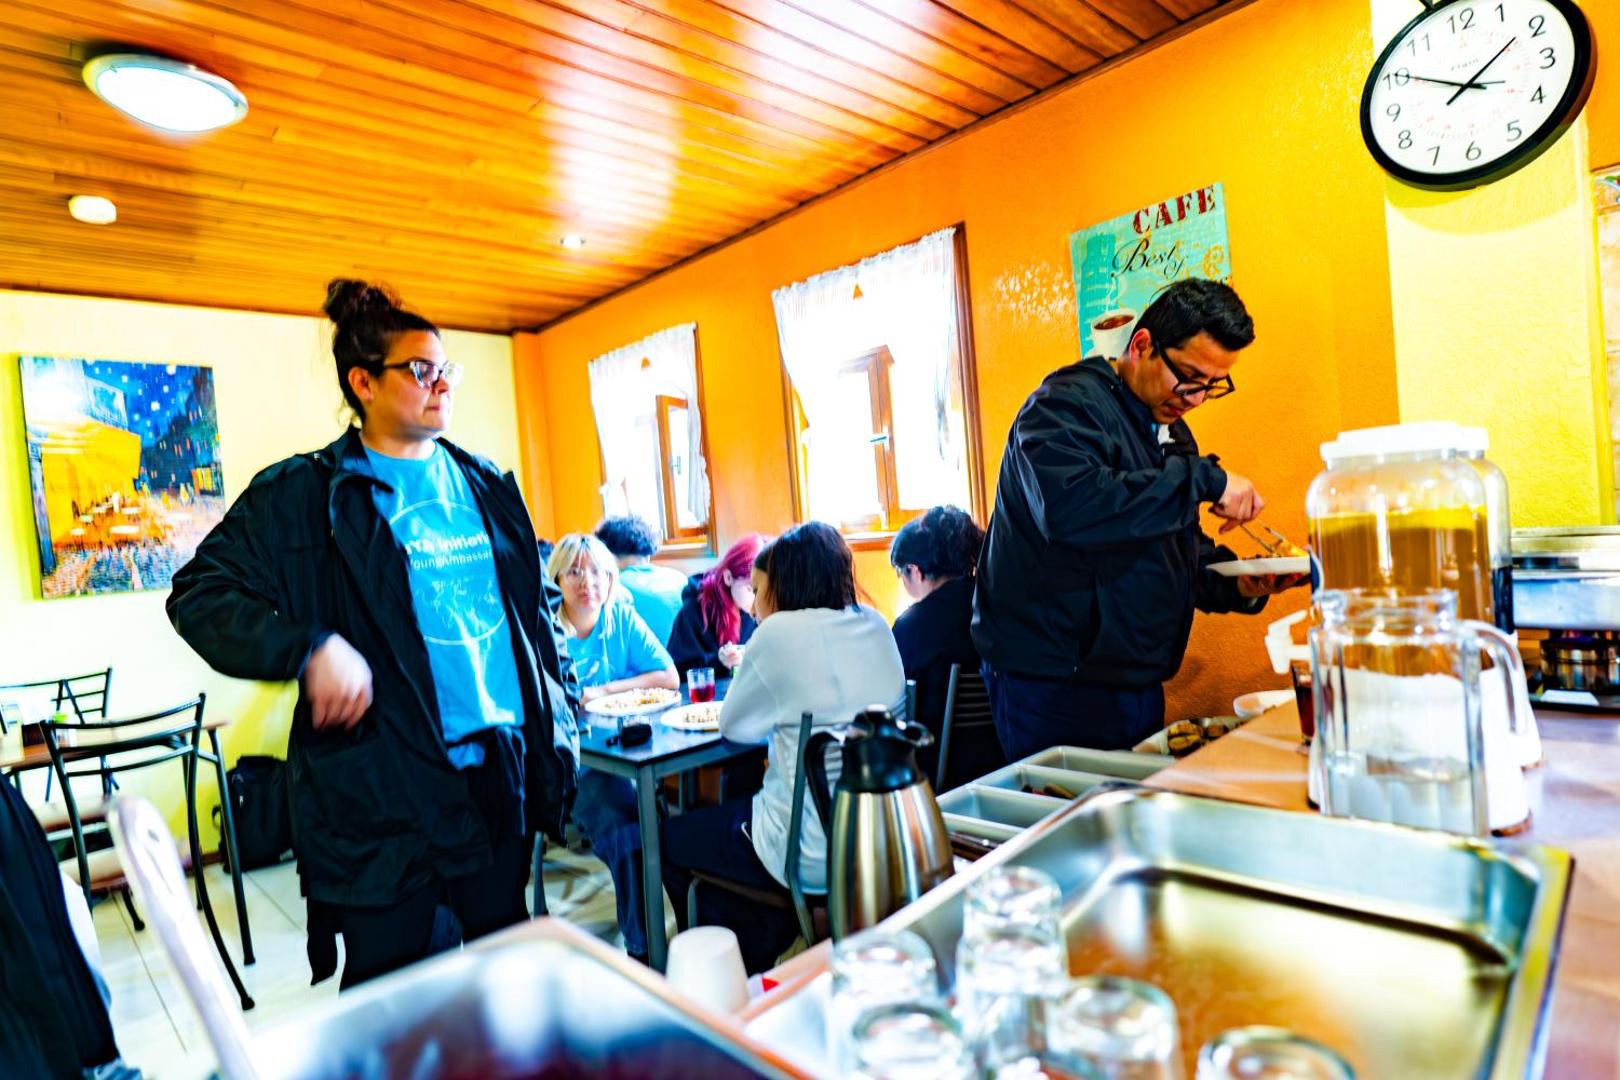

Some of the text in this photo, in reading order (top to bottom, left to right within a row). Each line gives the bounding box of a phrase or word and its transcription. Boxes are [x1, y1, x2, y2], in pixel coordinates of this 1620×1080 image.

[1446, 7, 1476, 35] 12
[1494, 3, 1506, 23] 1
[1528, 14, 1546, 39] 2
[1406, 33, 1432, 57] 11
[1539, 47, 1557, 70] 3
[1382, 67, 1410, 90] 10
[1530, 84, 1548, 105] 4
[1386, 103, 1402, 123] 9
[1397, 129, 1414, 150] 8
[1506, 119, 1523, 143] 5
[1427, 145, 1441, 167] 7
[1465, 140, 1483, 162] 6
[1132, 185, 1216, 235] CAFE
[1111, 238, 1177, 278] Best
